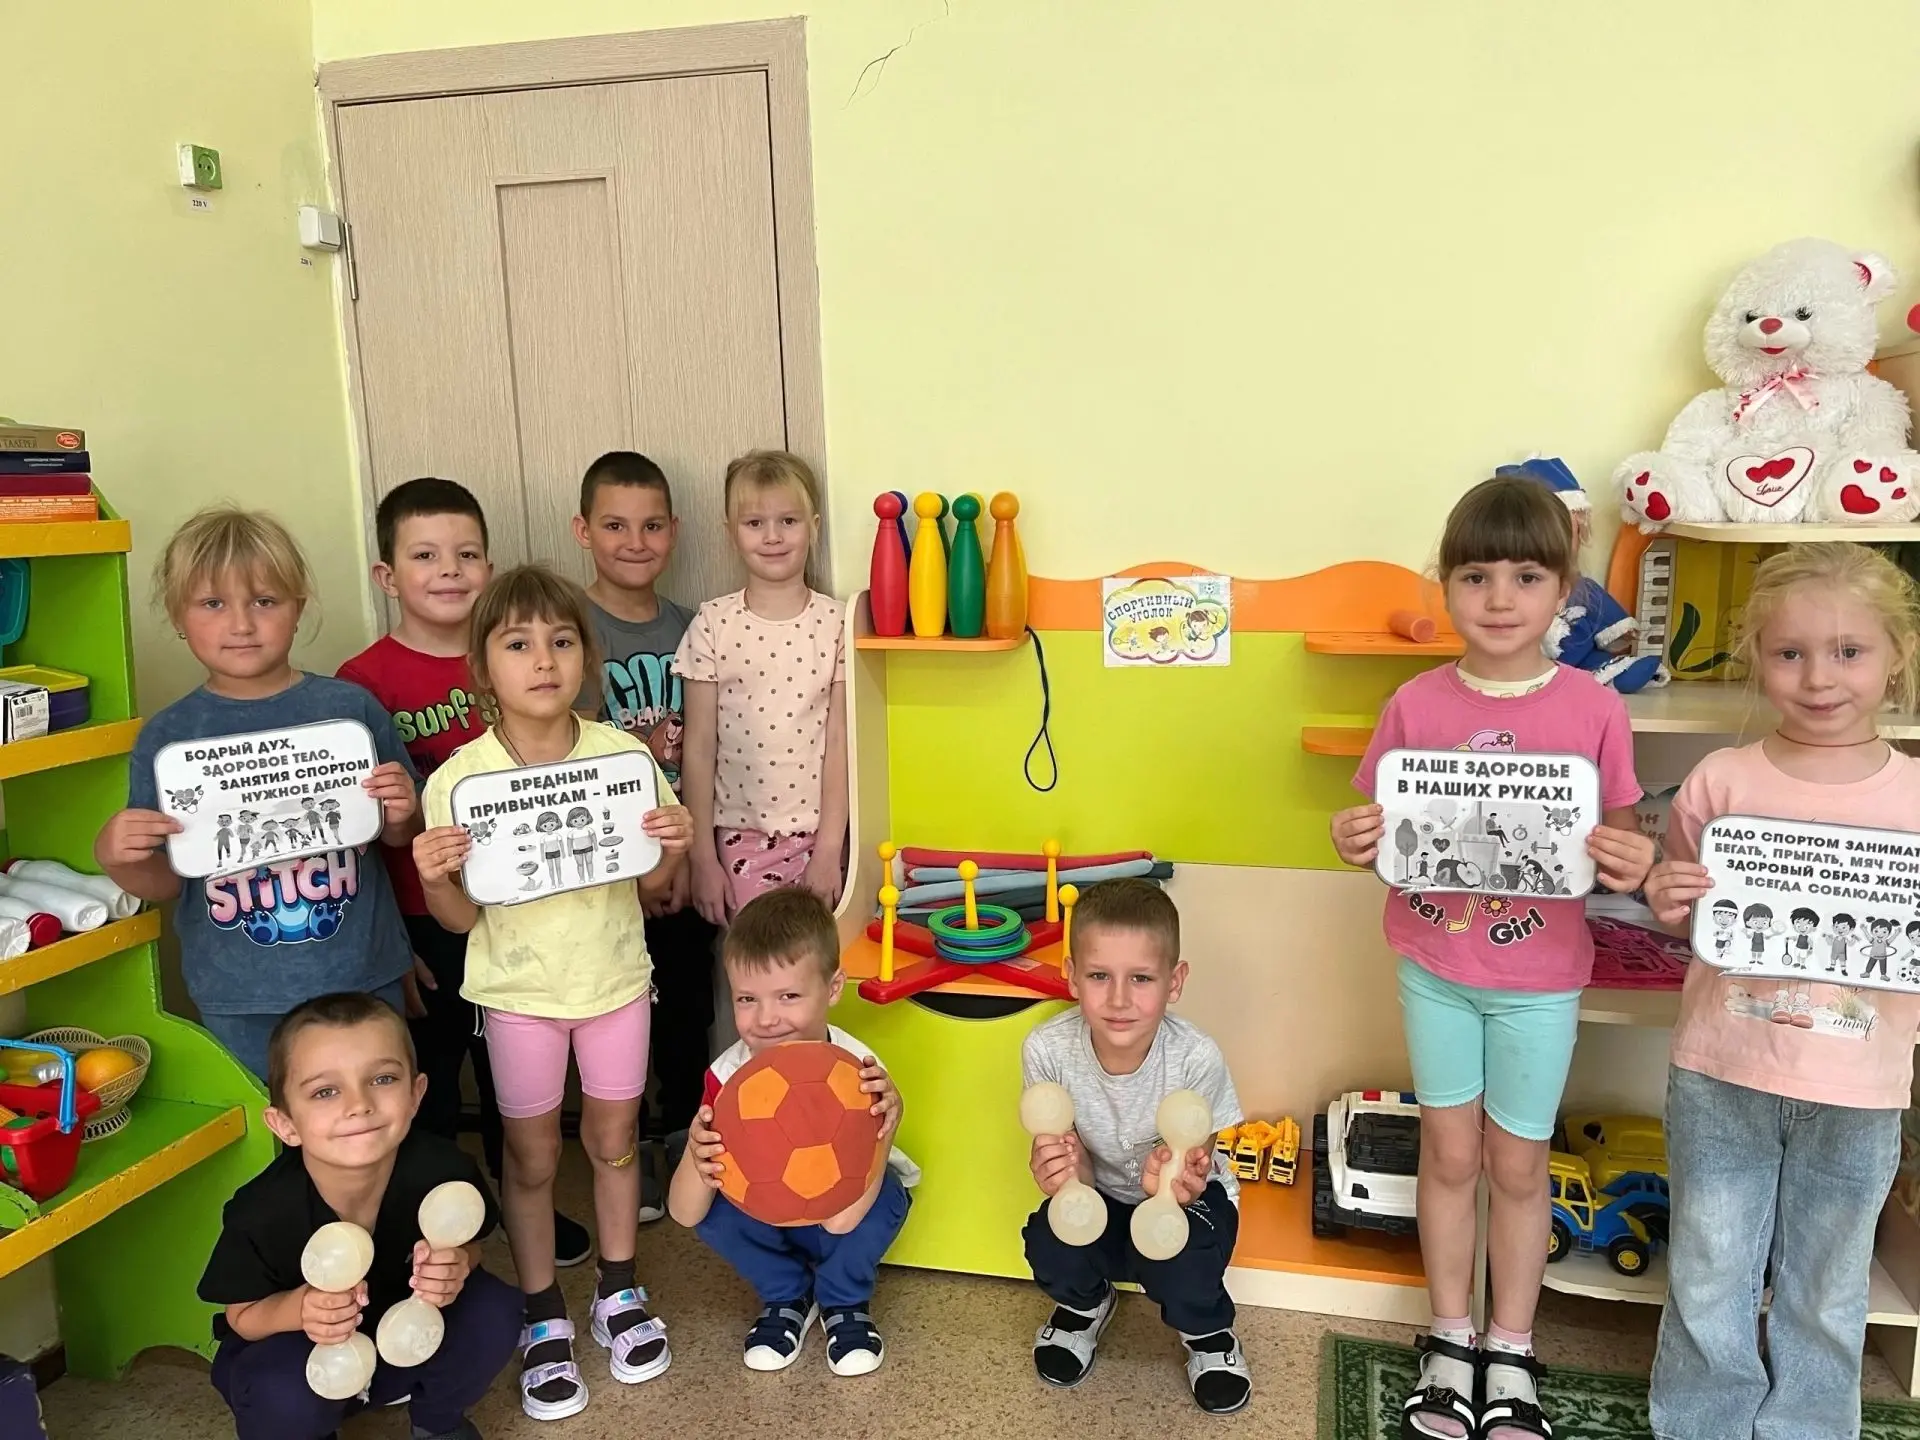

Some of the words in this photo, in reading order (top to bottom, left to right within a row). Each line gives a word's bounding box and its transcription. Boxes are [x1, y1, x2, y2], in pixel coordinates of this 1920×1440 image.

[1129, 608, 1173, 623] УГОЛОК
[185, 741, 253, 762] БОДРЫЙ
[258, 738, 295, 754] ДУХ,
[202, 755, 289, 777] ЗДОРОВОЕ
[292, 749, 335, 763] ТЕЛО,
[219, 771, 290, 791] ЗАНЯТИЯ
[295, 759, 370, 778] СПОРТОМ
[1402, 758, 1458, 774] НАШЕ
[1464, 760, 1570, 778] ЗДОРОВЬЕ
[241, 784, 309, 803] НУЖНОЕ
[313, 776, 357, 793] ДЕЛО!
[510, 768, 599, 793] ВРЕДНЫМ
[1398, 780, 1408, 793] В
[1415, 780, 1492, 798] НАШИХ
[1499, 784, 1573, 801] РУКАХ!
[469, 789, 587, 819] ПРИВЫЧКАМ
[606, 779, 641, 796] НЕТ!
[1711, 827, 1756, 841] НАДО
[1761, 831, 1840, 849] СПОРТОМ
[1714, 843, 1767, 859] БЕГАТЬ,
[1773, 848, 1844, 867] ПРЫГАТЬ,
[1850, 856, 1883, 870] МЯЧ
[1889, 861, 1920, 873] ГОН
[1726, 859, 1814, 878] ЗДОРОВЫЙ
[1819, 868, 1870, 884] ОБРАЗ
[1745, 876, 1802, 893] ВСЕГДА
[1409, 893, 1445, 925] eet
[1489, 908, 1545, 945] Girl
